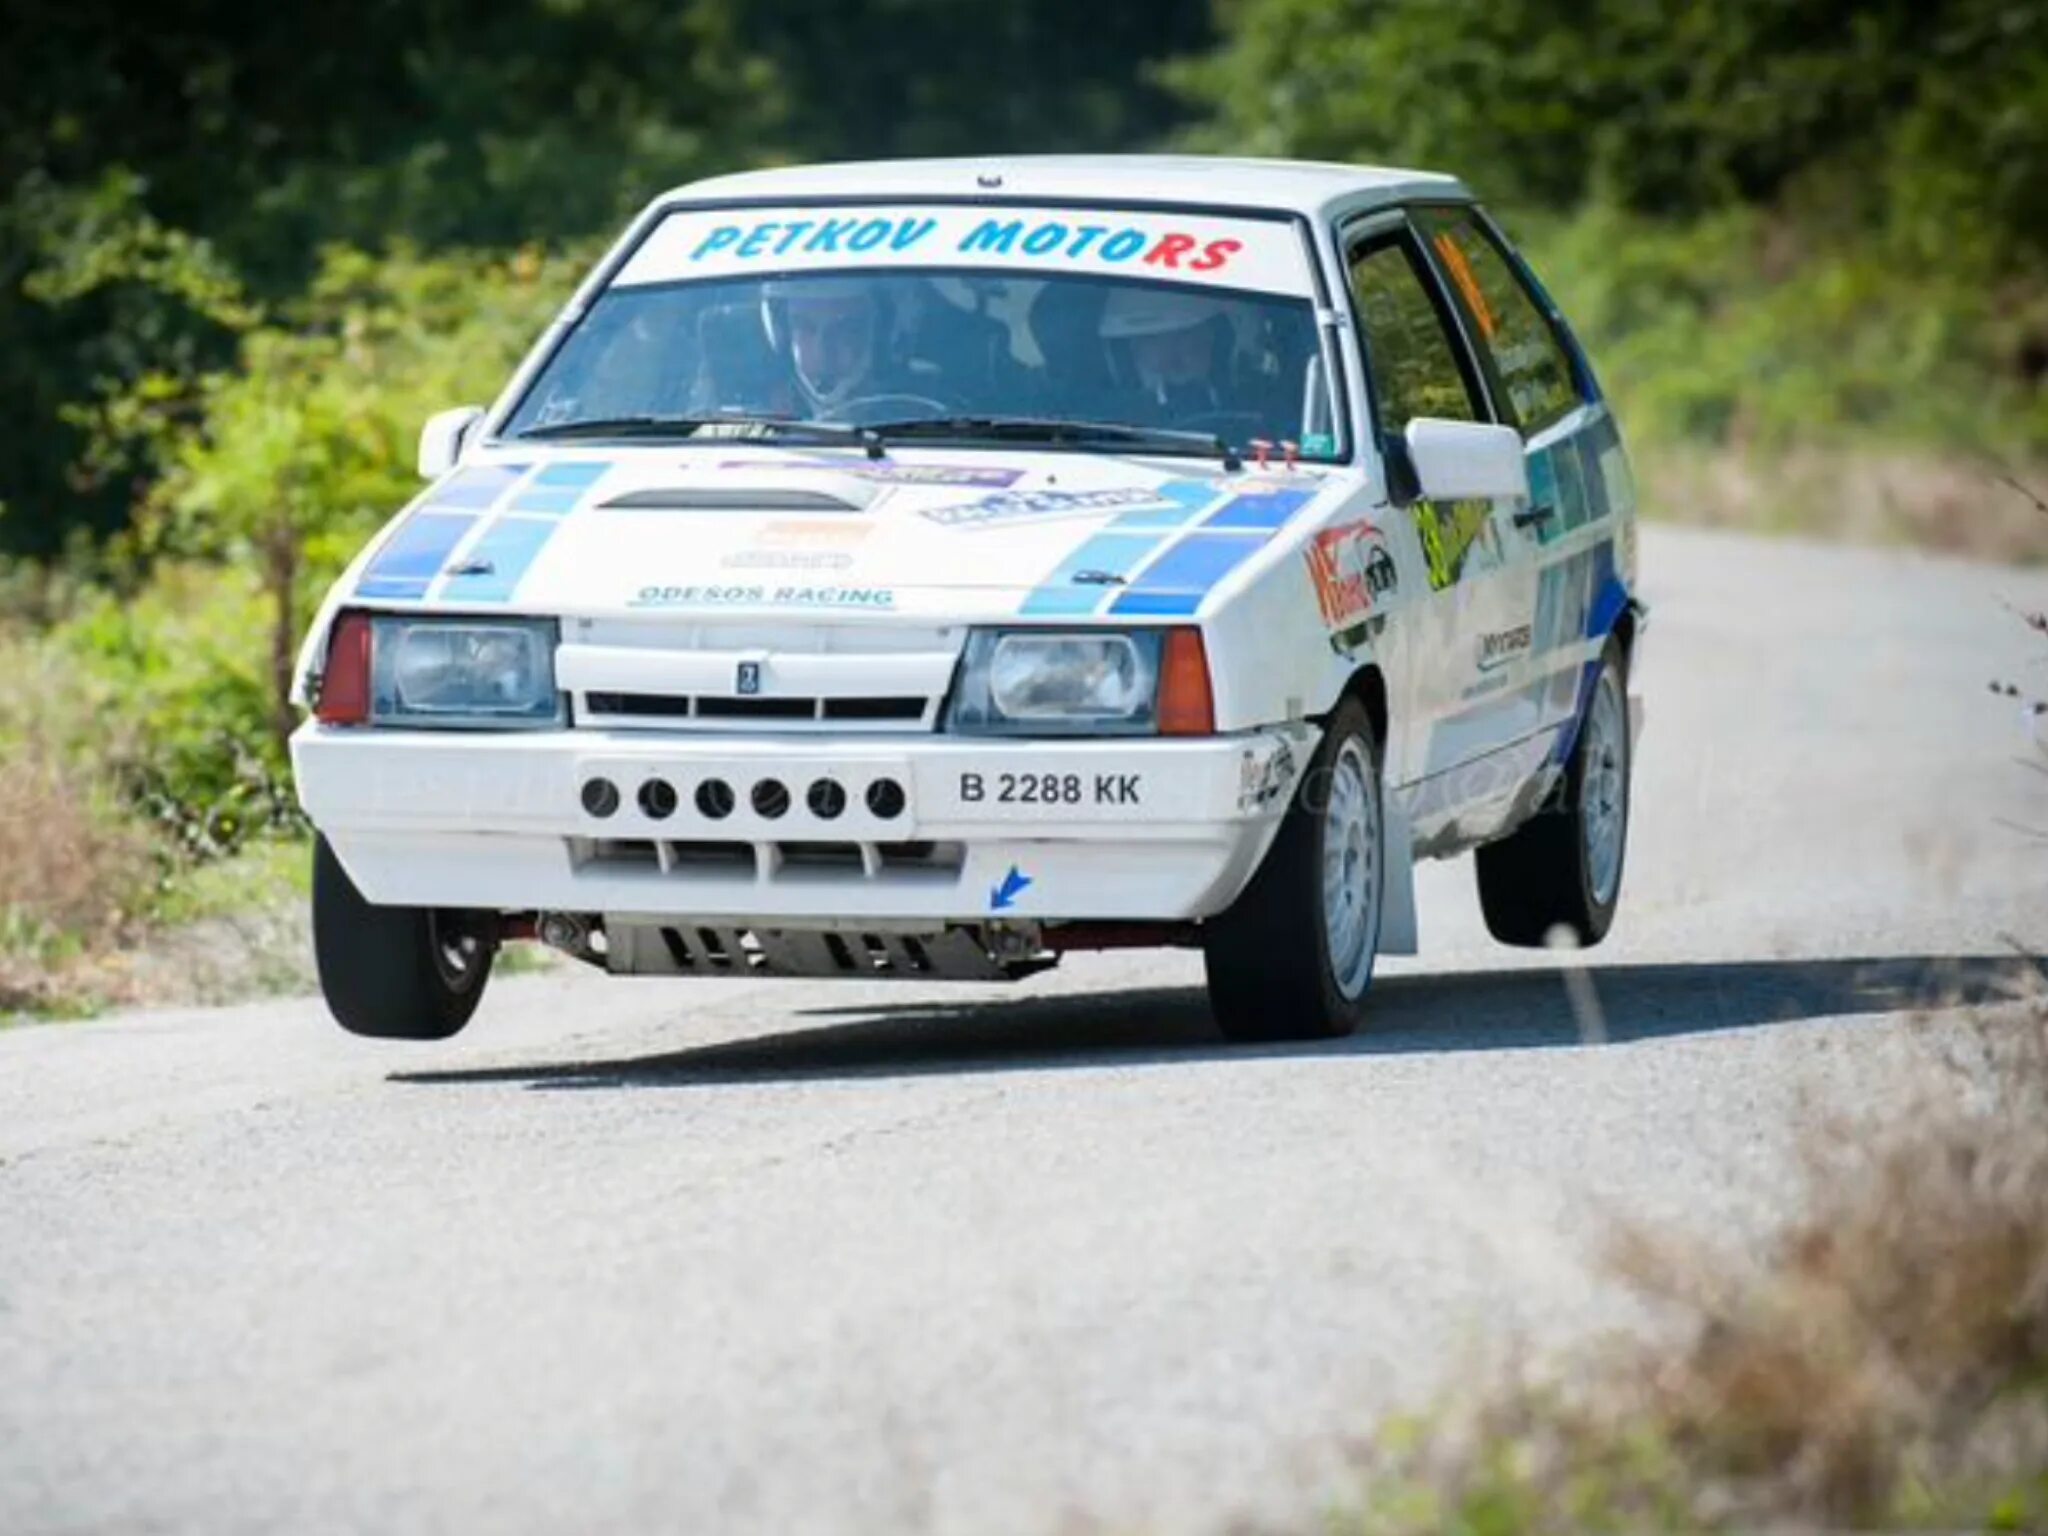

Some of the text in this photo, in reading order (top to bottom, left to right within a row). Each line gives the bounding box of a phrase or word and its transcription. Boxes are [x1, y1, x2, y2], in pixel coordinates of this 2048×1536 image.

[690, 218, 1243, 271] PETKOV MOTORS
[637, 585, 894, 604] ODESOS RACING
[960, 772, 1141, 804] B 2288 KK
